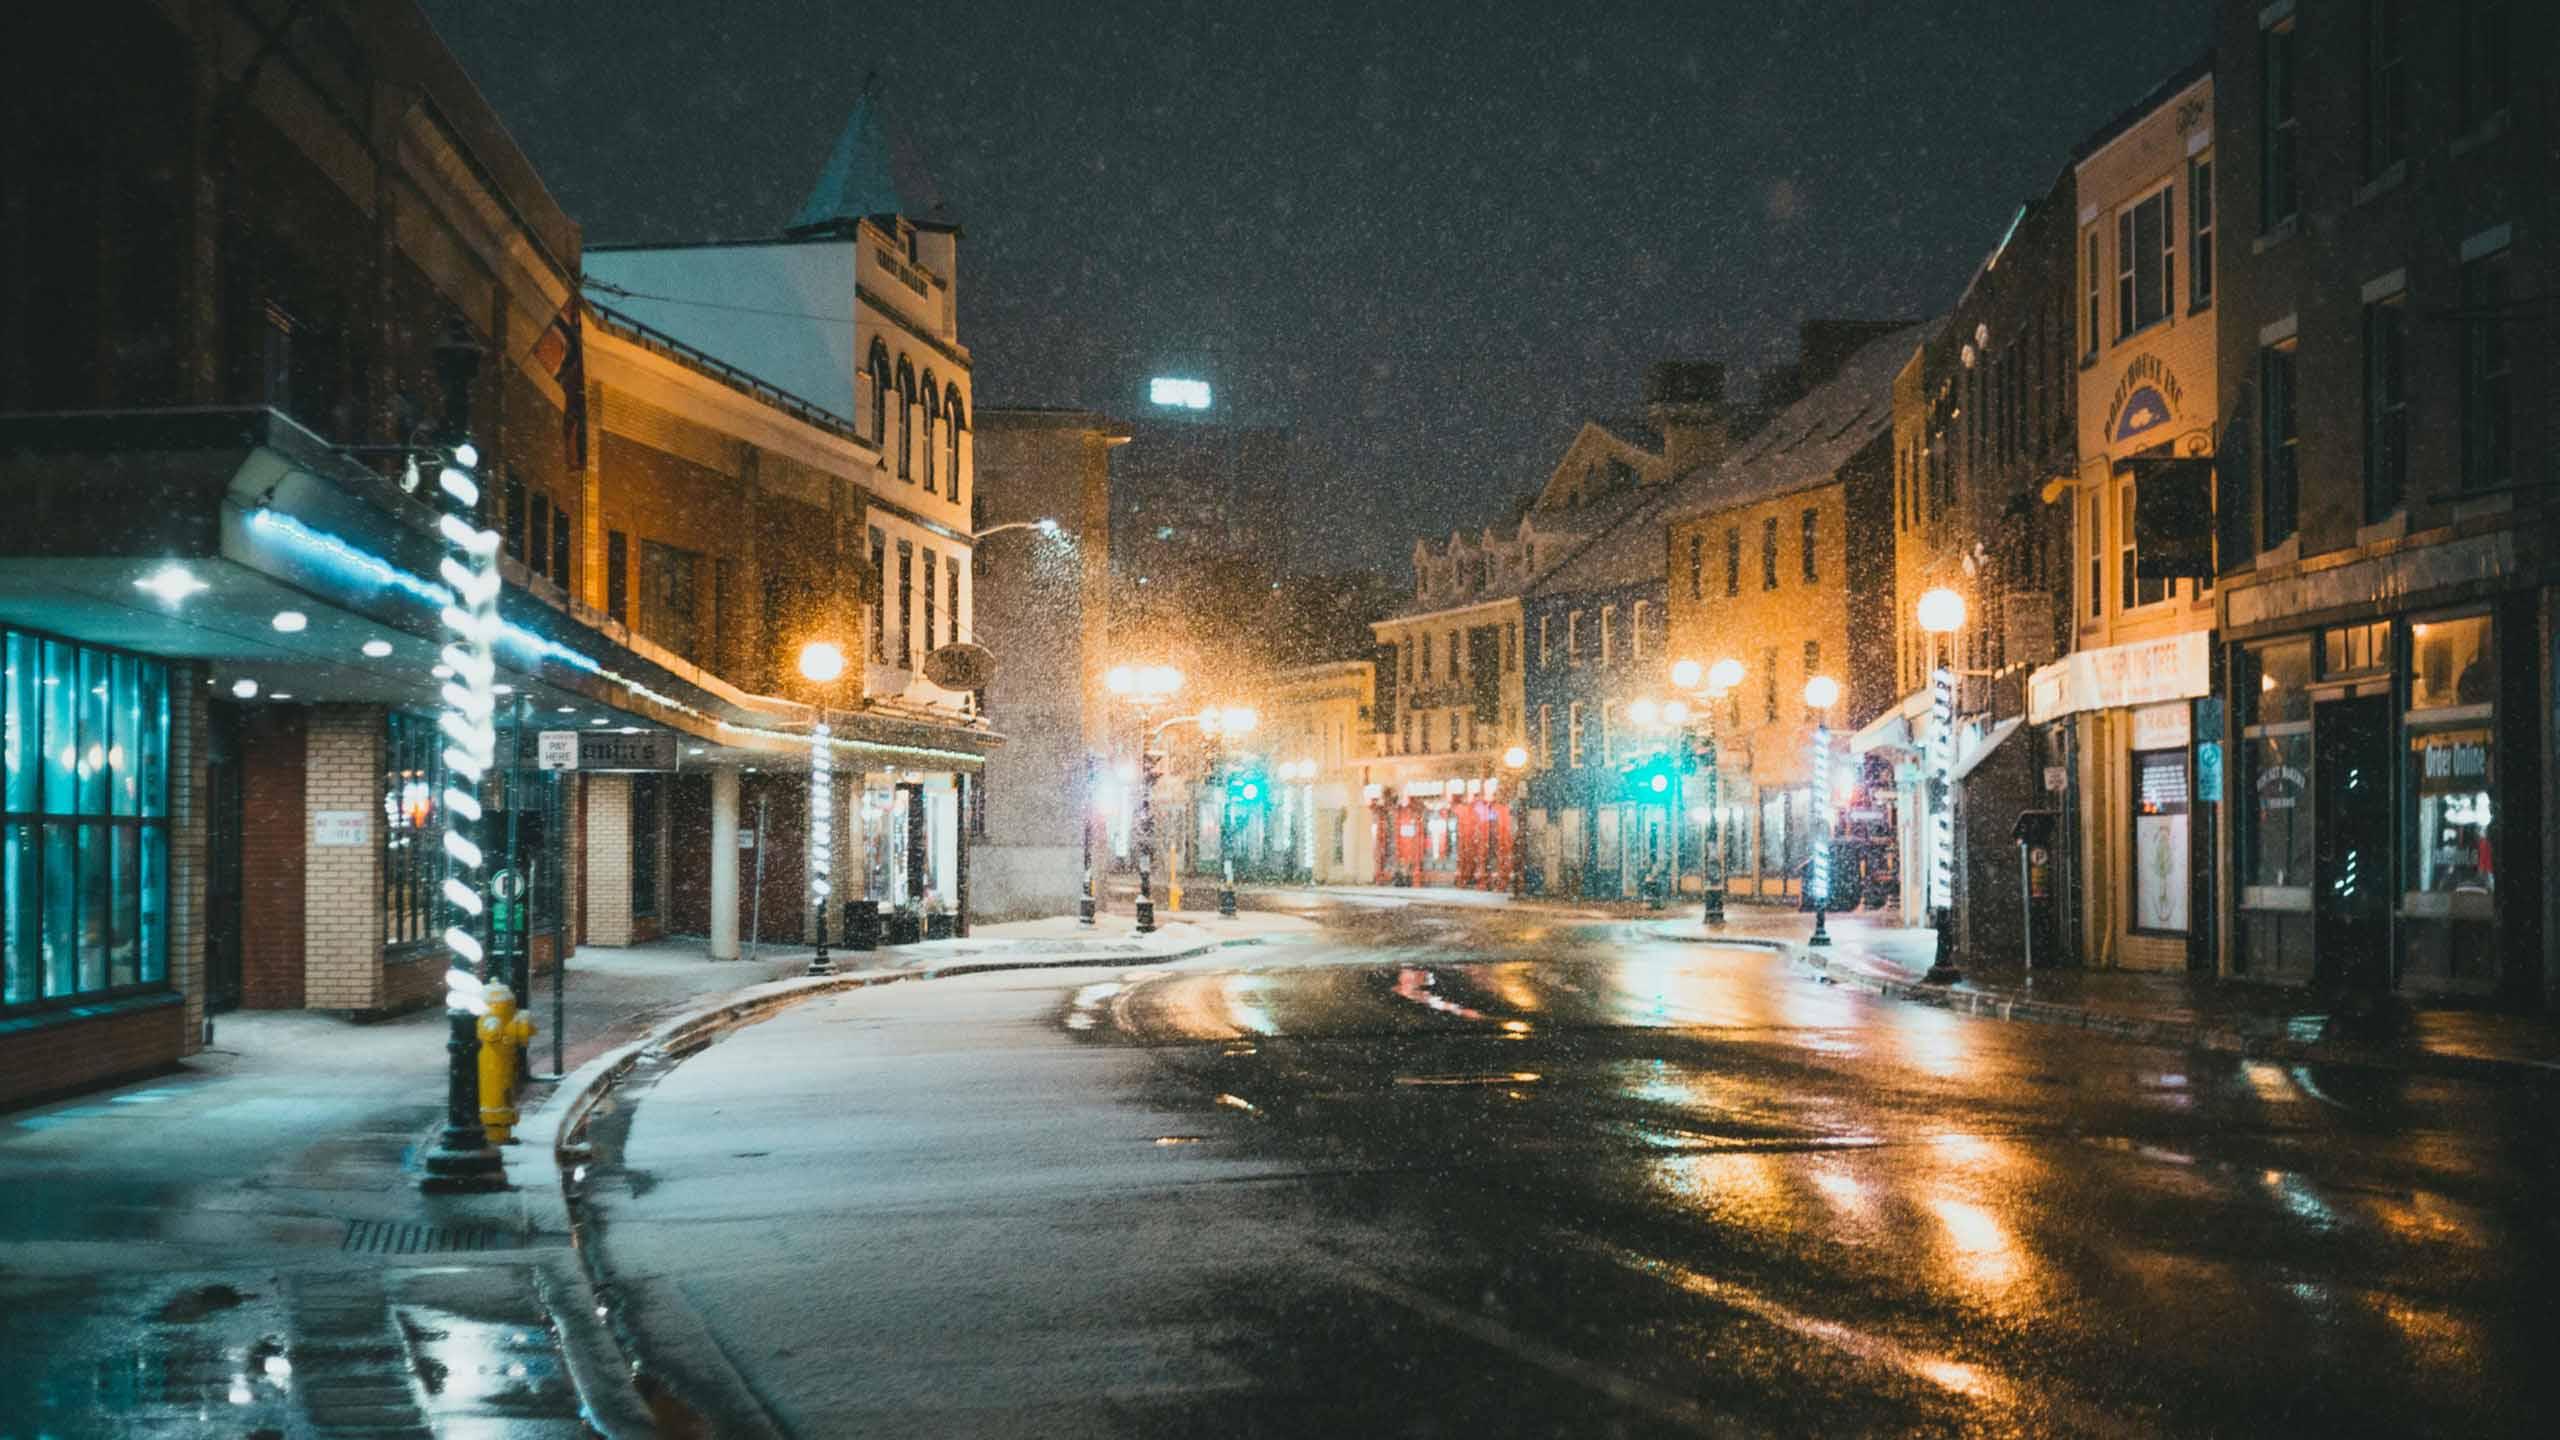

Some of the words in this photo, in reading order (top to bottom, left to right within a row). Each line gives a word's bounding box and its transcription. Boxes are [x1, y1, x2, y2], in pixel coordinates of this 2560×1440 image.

[549, 741, 568, 751] PAY
[545, 751, 572, 762] HERE
[2425, 743, 2452, 777] Order
[2453, 742, 2486, 776] Online
